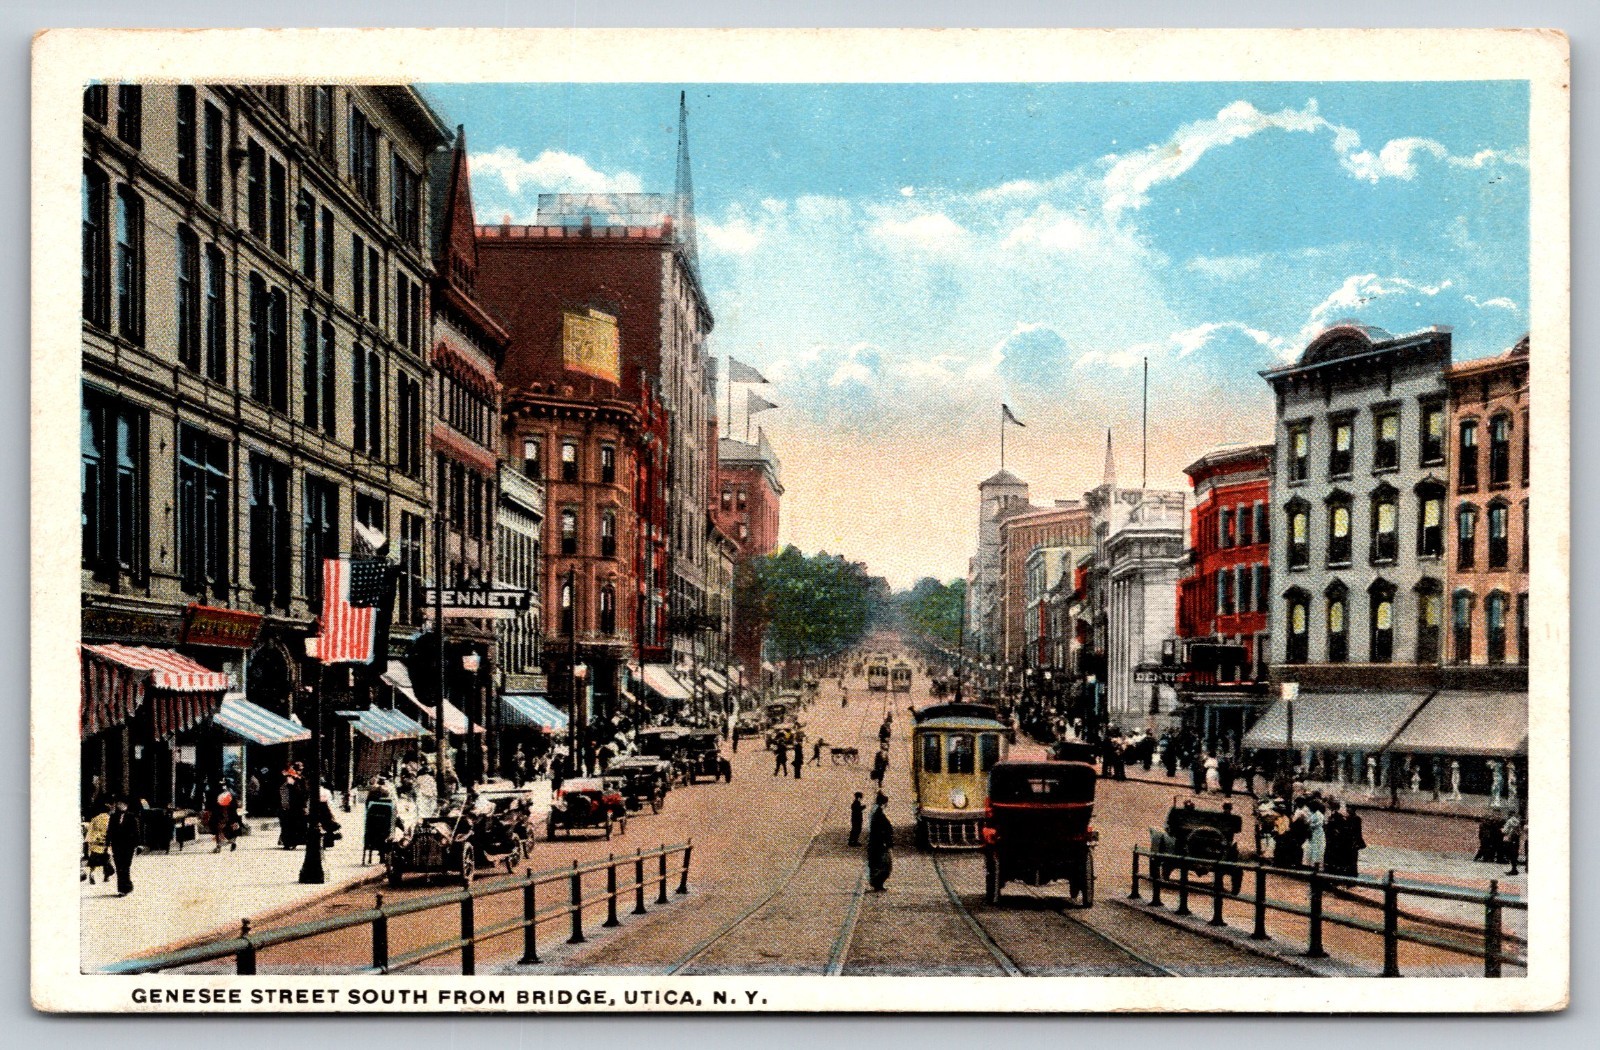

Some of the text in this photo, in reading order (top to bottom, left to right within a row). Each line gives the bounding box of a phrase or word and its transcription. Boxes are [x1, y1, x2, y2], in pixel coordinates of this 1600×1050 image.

[425, 590, 525, 606] BENNETT
[131, 988, 767, 1006] GENESEE STREET SOUTH FROM BRIDGE, UTICA, N. Y.
